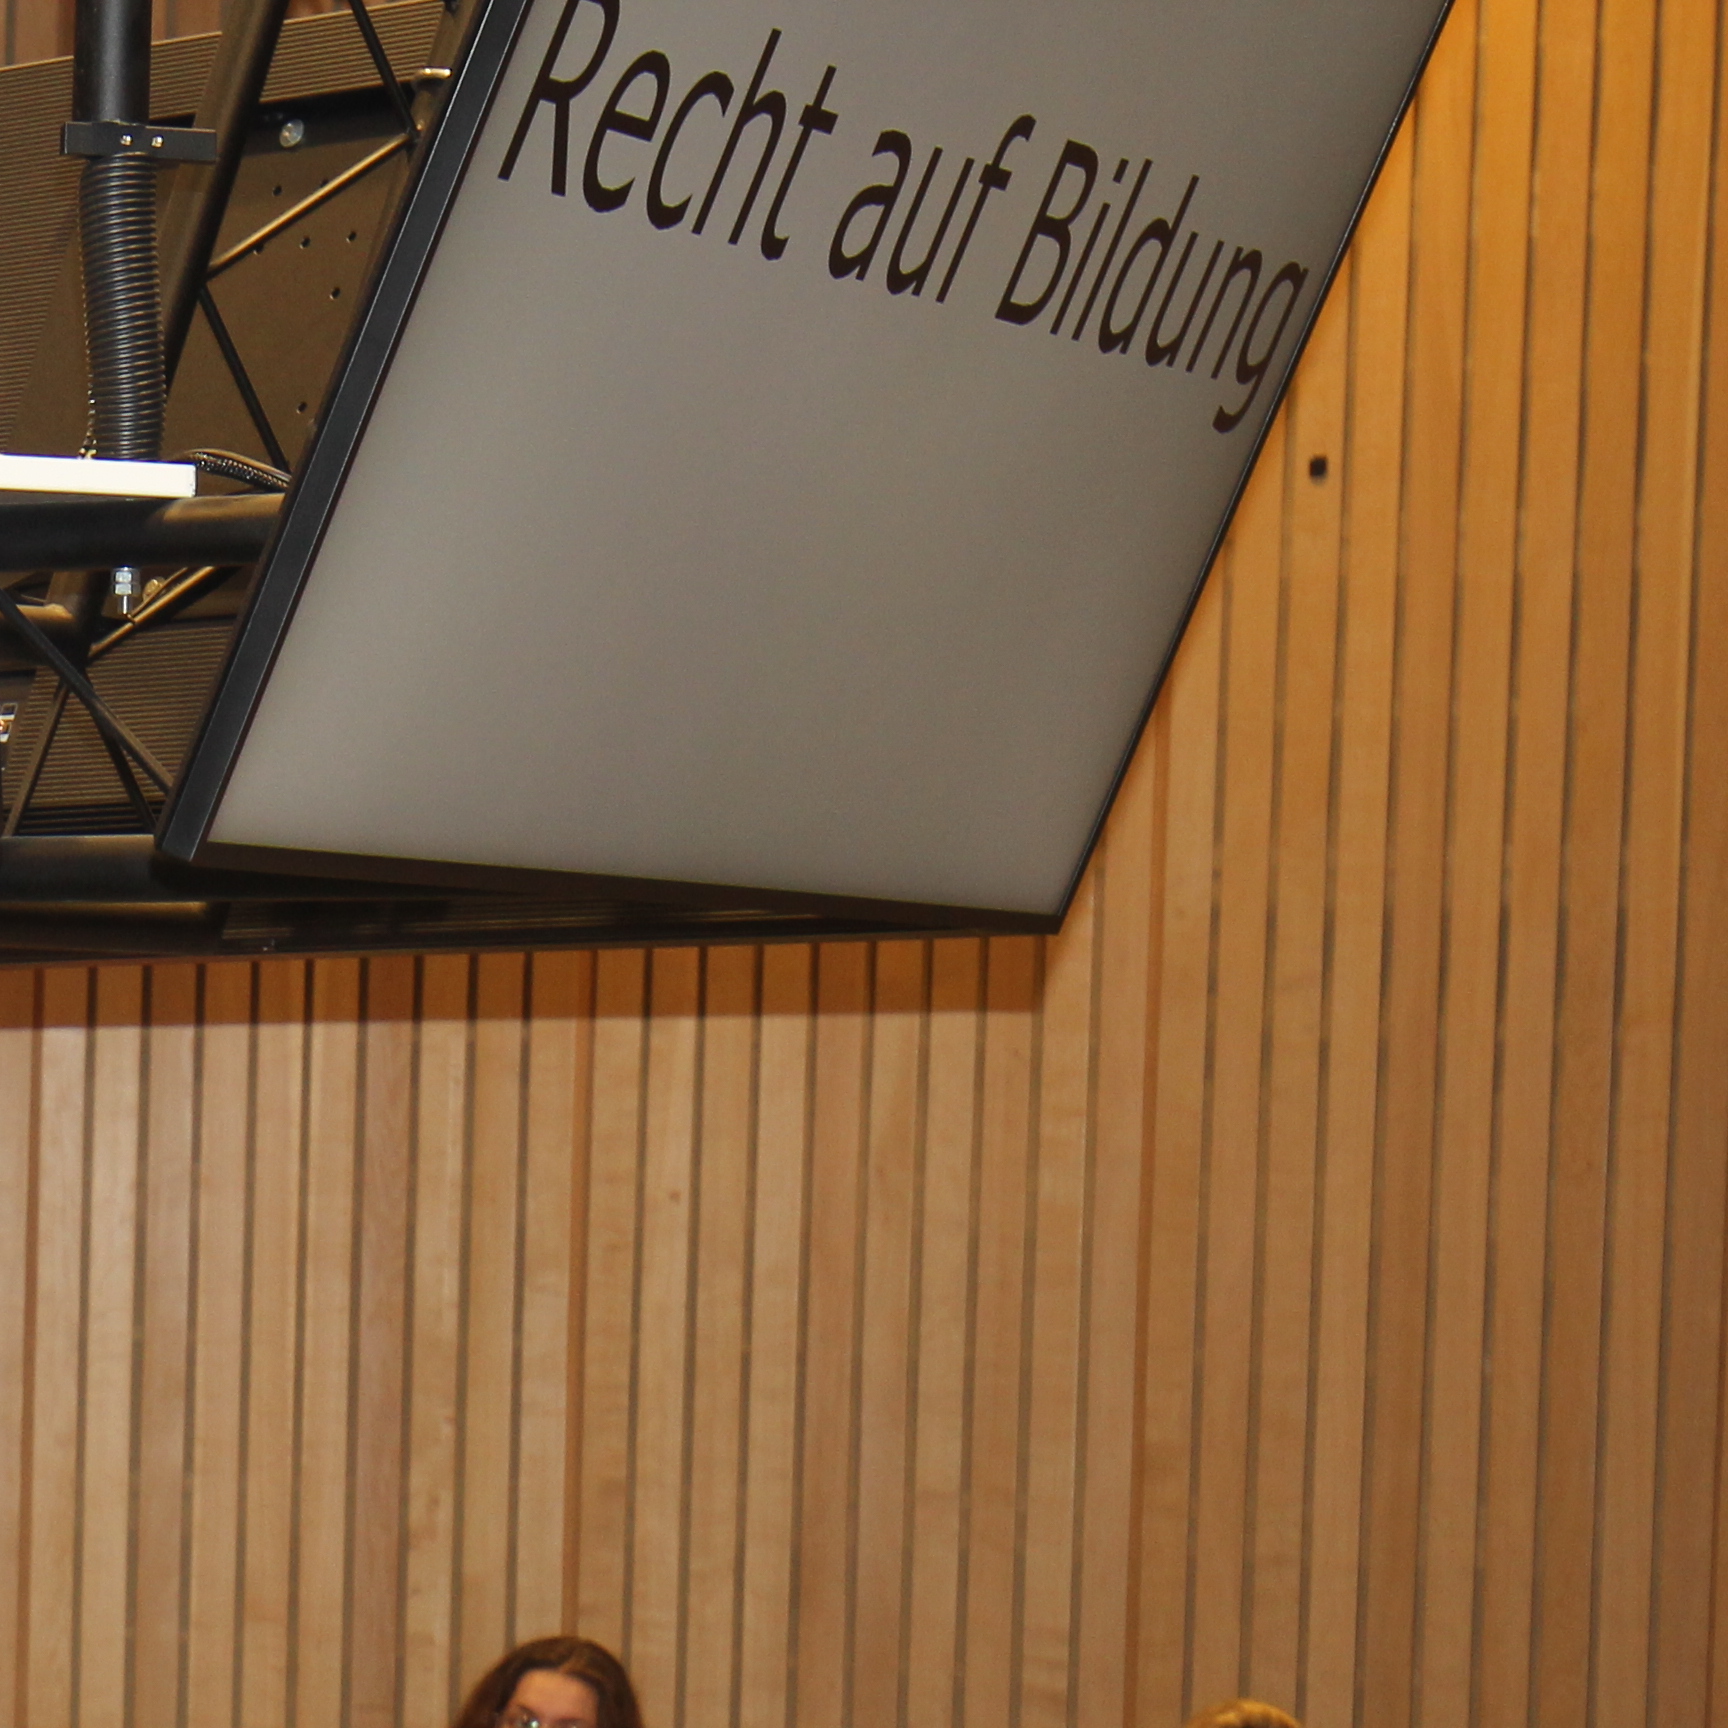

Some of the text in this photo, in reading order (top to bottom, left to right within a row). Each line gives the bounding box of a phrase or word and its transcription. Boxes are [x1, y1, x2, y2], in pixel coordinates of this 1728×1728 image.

[497, 0, 1310, 435] Recht auf Bildung
